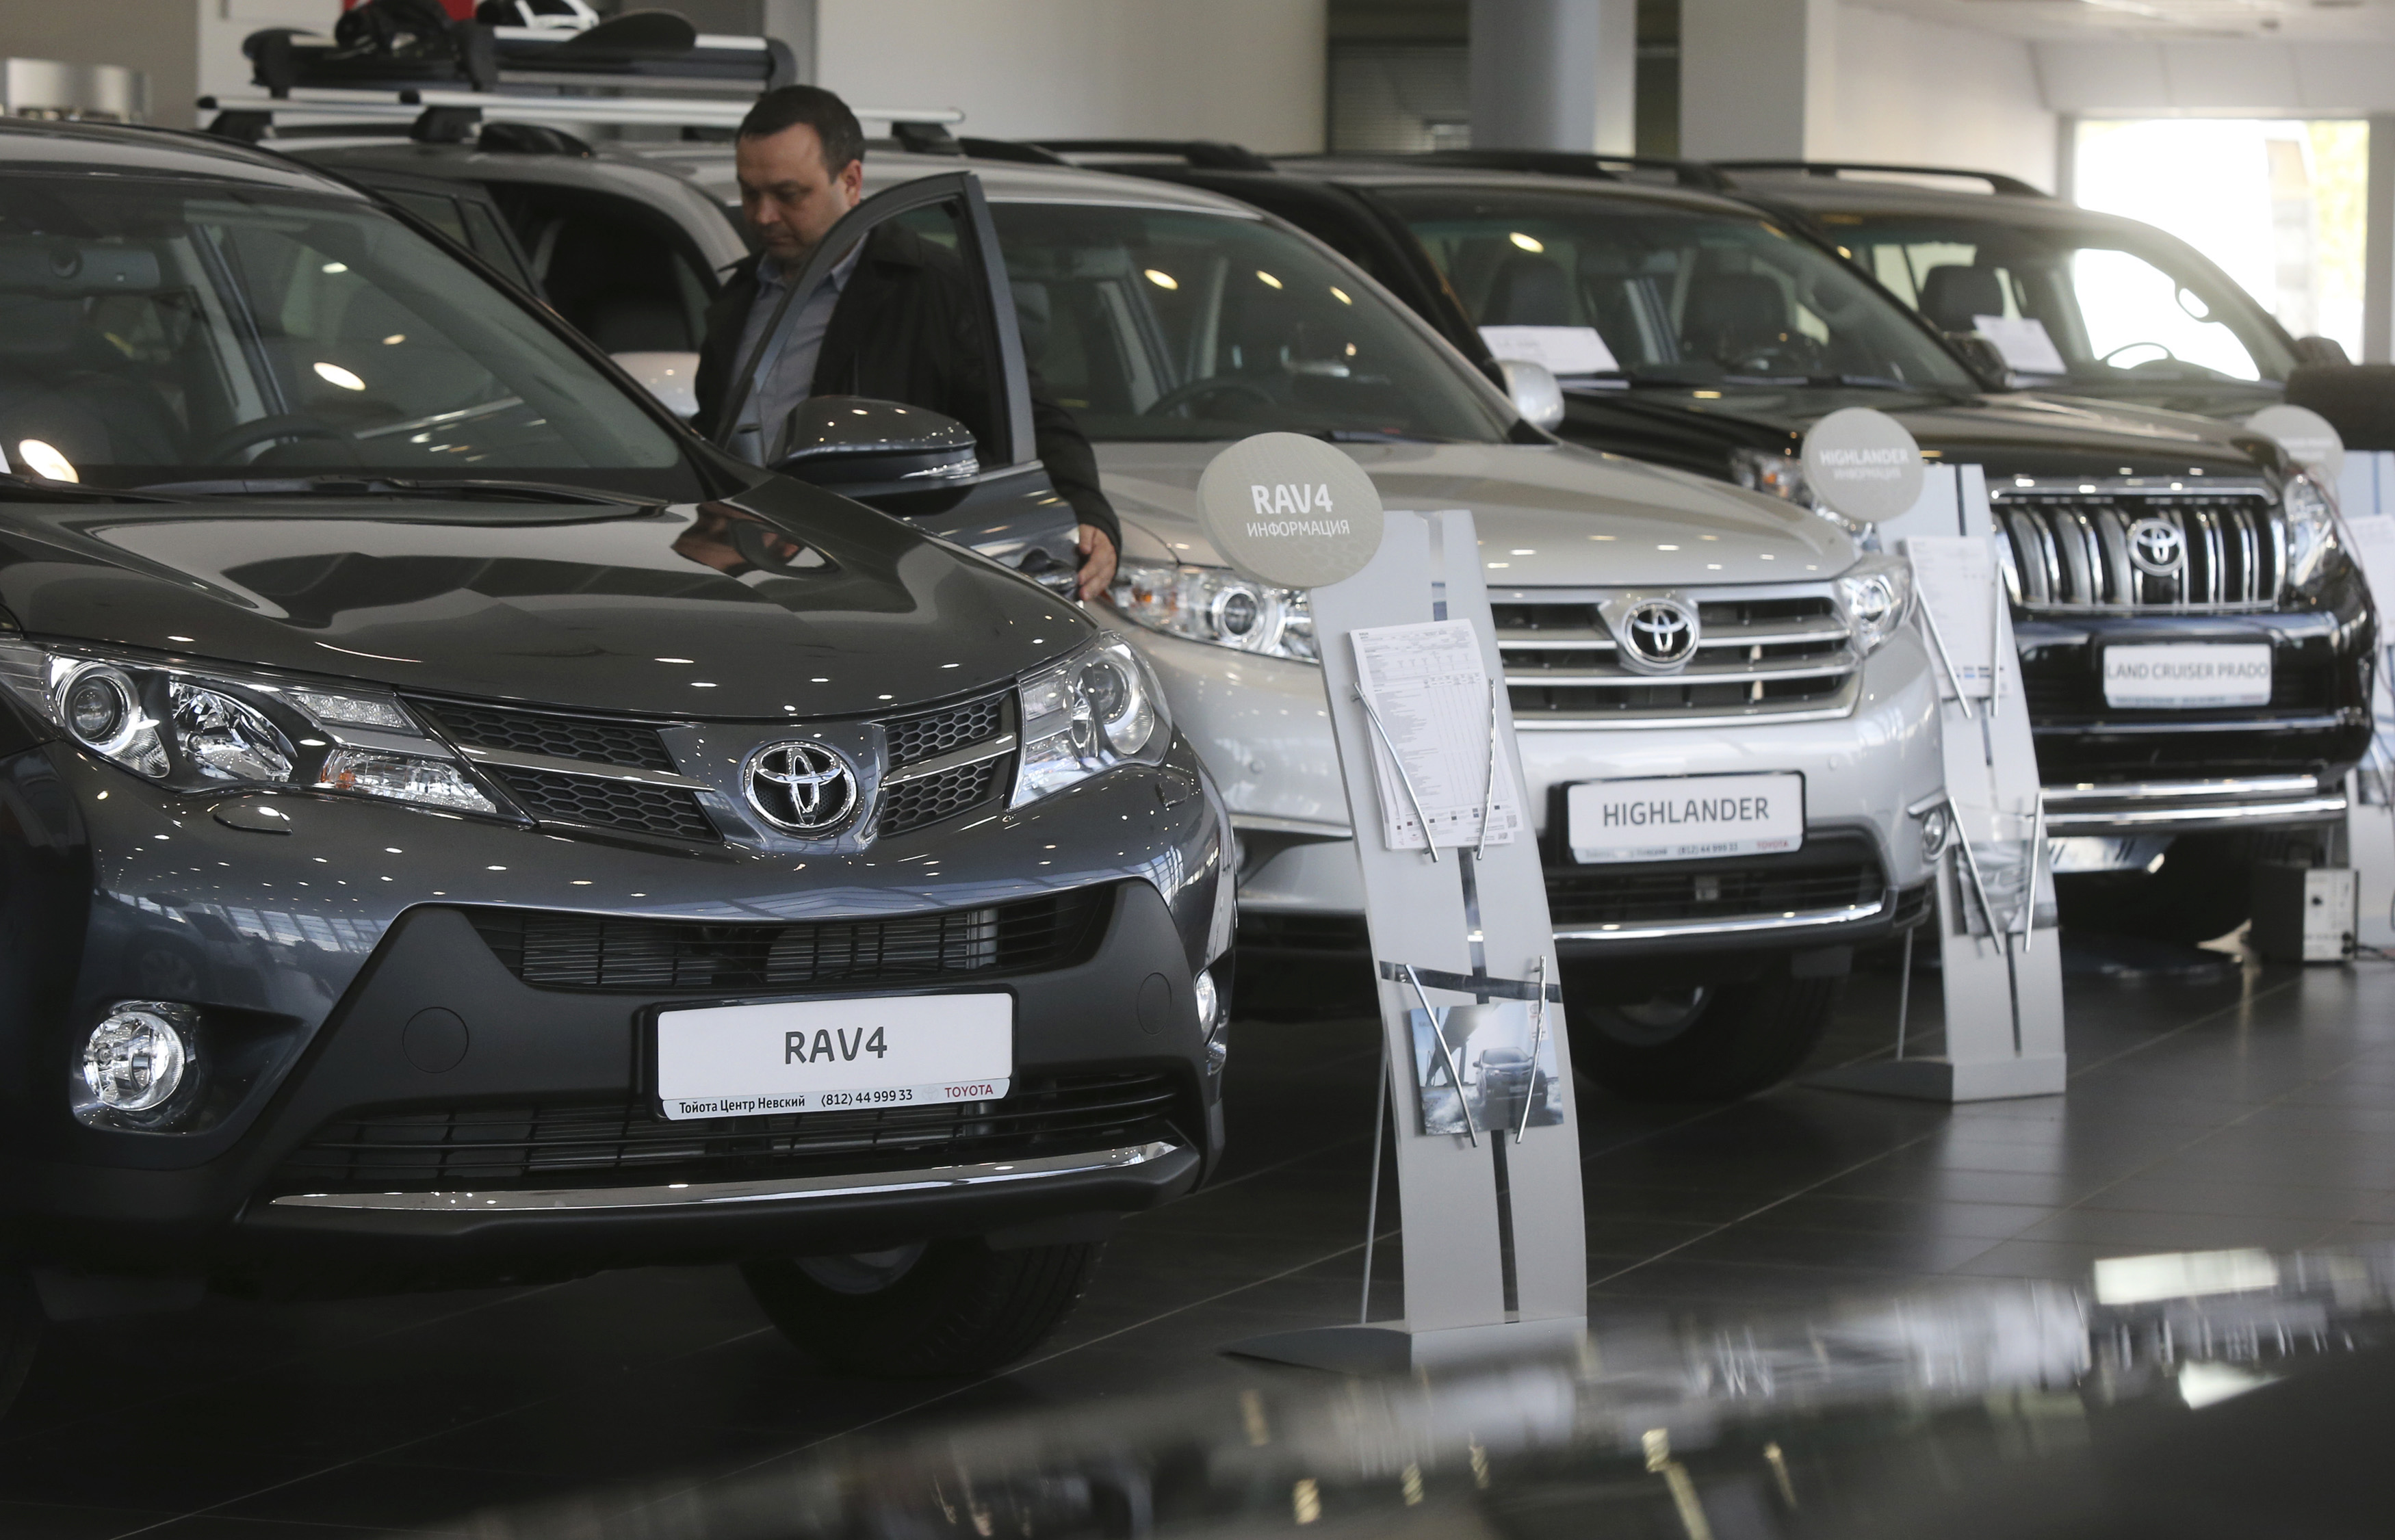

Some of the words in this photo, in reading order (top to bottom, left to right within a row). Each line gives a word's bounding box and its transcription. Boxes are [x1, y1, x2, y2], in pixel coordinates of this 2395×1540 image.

[1820, 448, 1910, 467] HIGHLANDER
[1251, 483, 1334, 514] RAV4
[1246, 519, 1351, 538] ИНФОРМАЦИЯ
[2107, 662, 2149, 679] LAND
[2152, 662, 2215, 680] CRUISER
[2218, 661, 2269, 679] PRADO
[1603, 797, 1770, 826] HIGHLANDER
[786, 1026, 888, 1065] RAV4
[821, 1093, 853, 1108] (812)
[855, 1092, 871, 1104] 44
[874, 1091, 896, 1103] 999
[898, 1088, 913, 1101] 33
[944, 1084, 994, 1099] TOYOTA
[679, 1101, 718, 1114] Тойота
[721, 1099, 755, 1112] Центр
[758, 1095, 805, 1109] Невский
